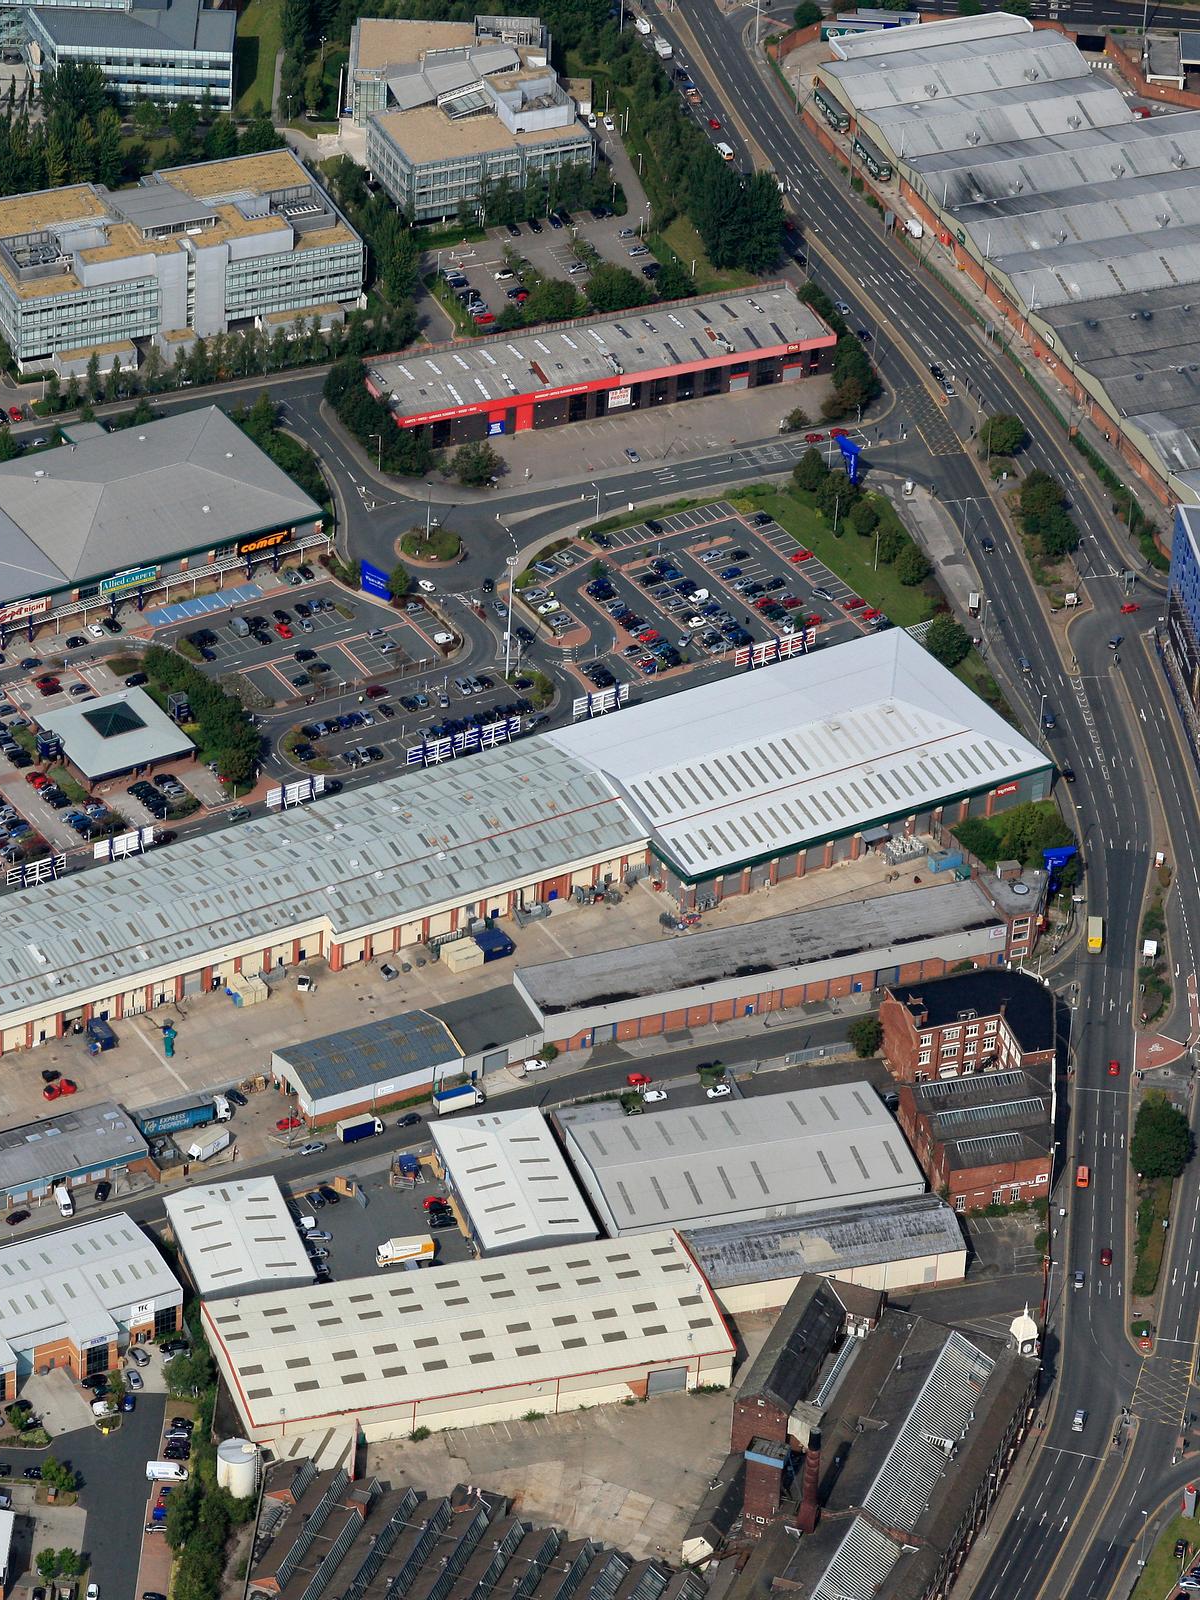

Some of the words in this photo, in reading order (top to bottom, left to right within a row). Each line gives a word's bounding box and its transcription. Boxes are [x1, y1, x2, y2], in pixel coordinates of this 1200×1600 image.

[240, 535, 284, 552] COMET
[102, 578, 125, 590] Allied
[126, 571, 156, 582] CARPETS
[159, 1112, 186, 1124] EXPRESS
